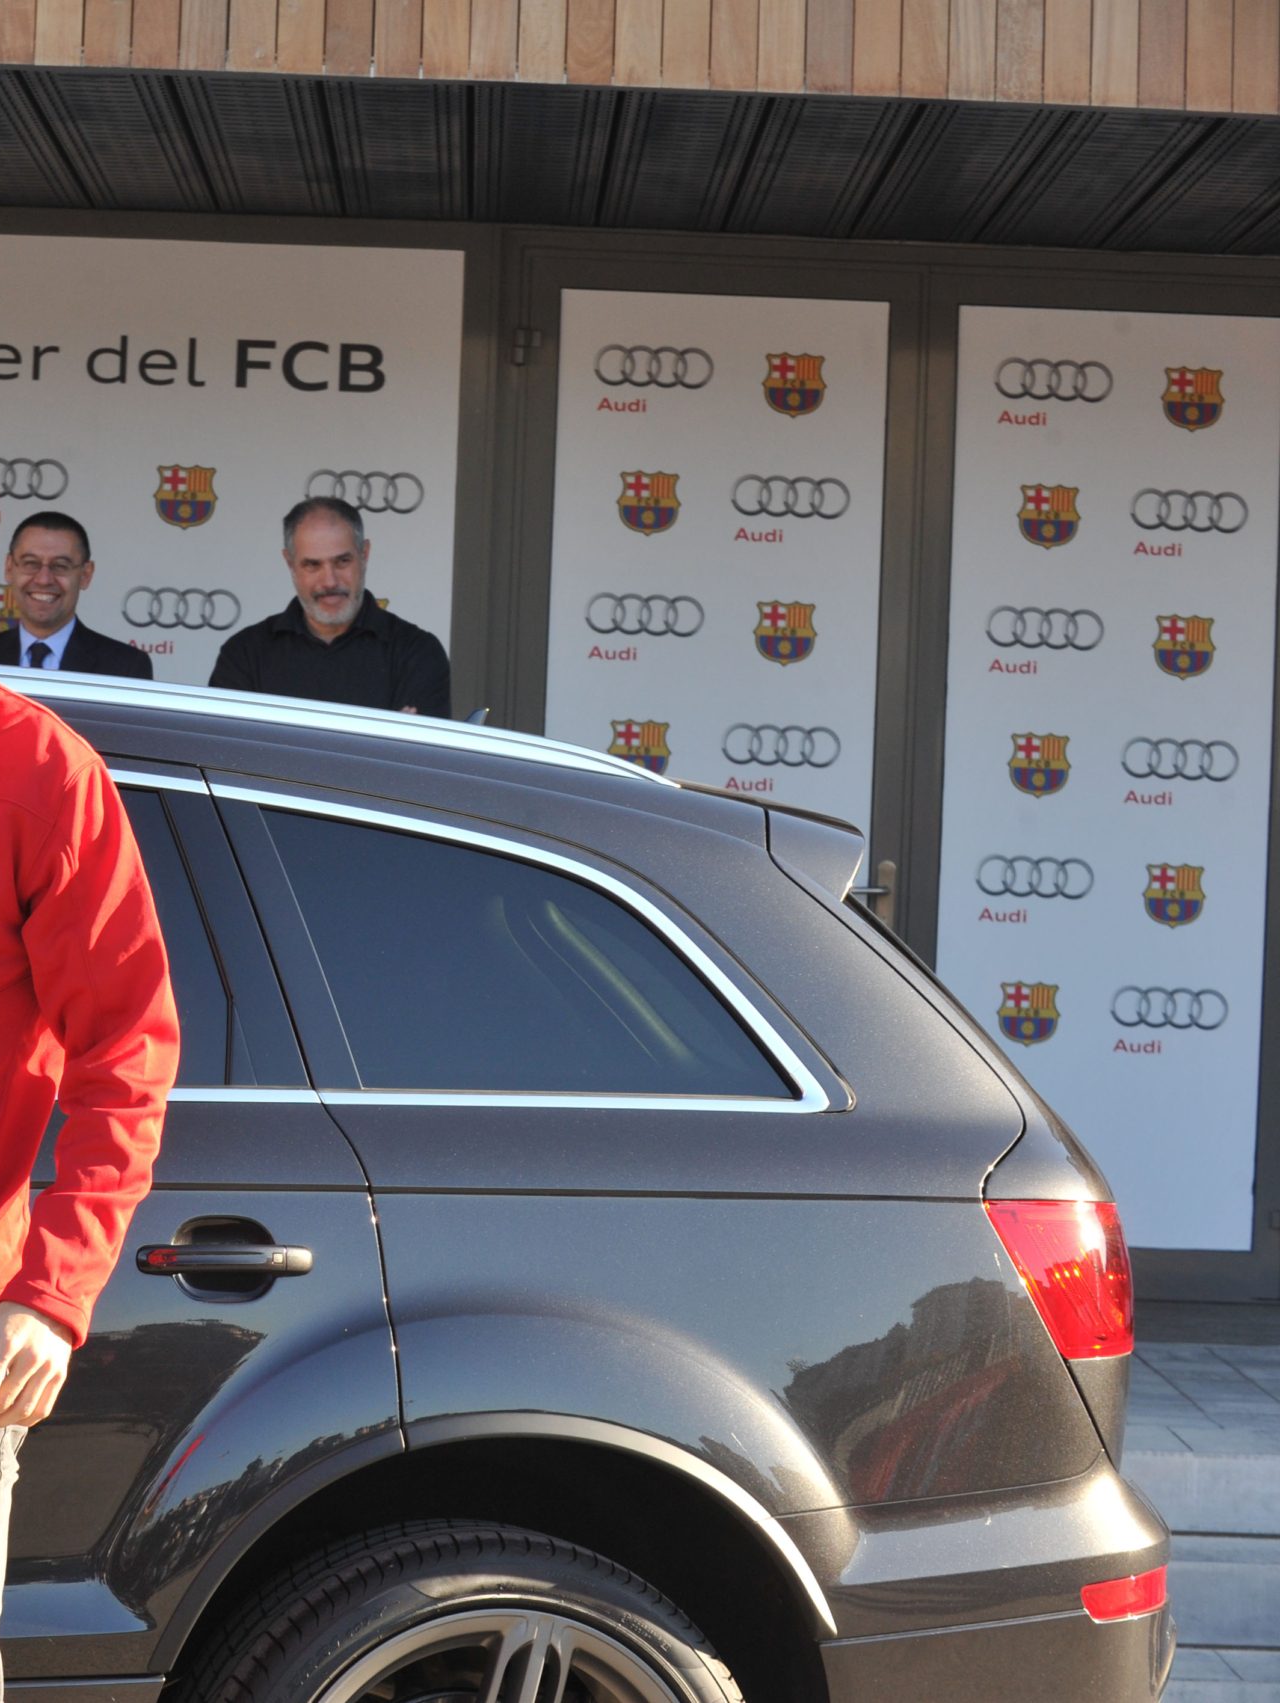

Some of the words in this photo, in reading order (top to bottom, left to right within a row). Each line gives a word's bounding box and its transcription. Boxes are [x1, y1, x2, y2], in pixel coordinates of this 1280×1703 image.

[87, 335, 206, 388] del
[235, 339, 386, 393] FCB
[597, 397, 647, 412] Audi
[998, 410, 1047, 426] Audi
[735, 528, 784, 543] Audi
[1135, 542, 1183, 557] Audi
[588, 646, 637, 660] Audi
[989, 658, 1038, 674] Audi
[724, 778, 773, 792] Audi
[1124, 790, 1173, 805] Audi
[979, 907, 1028, 923] Audi
[1113, 1039, 1162, 1054] Audi
